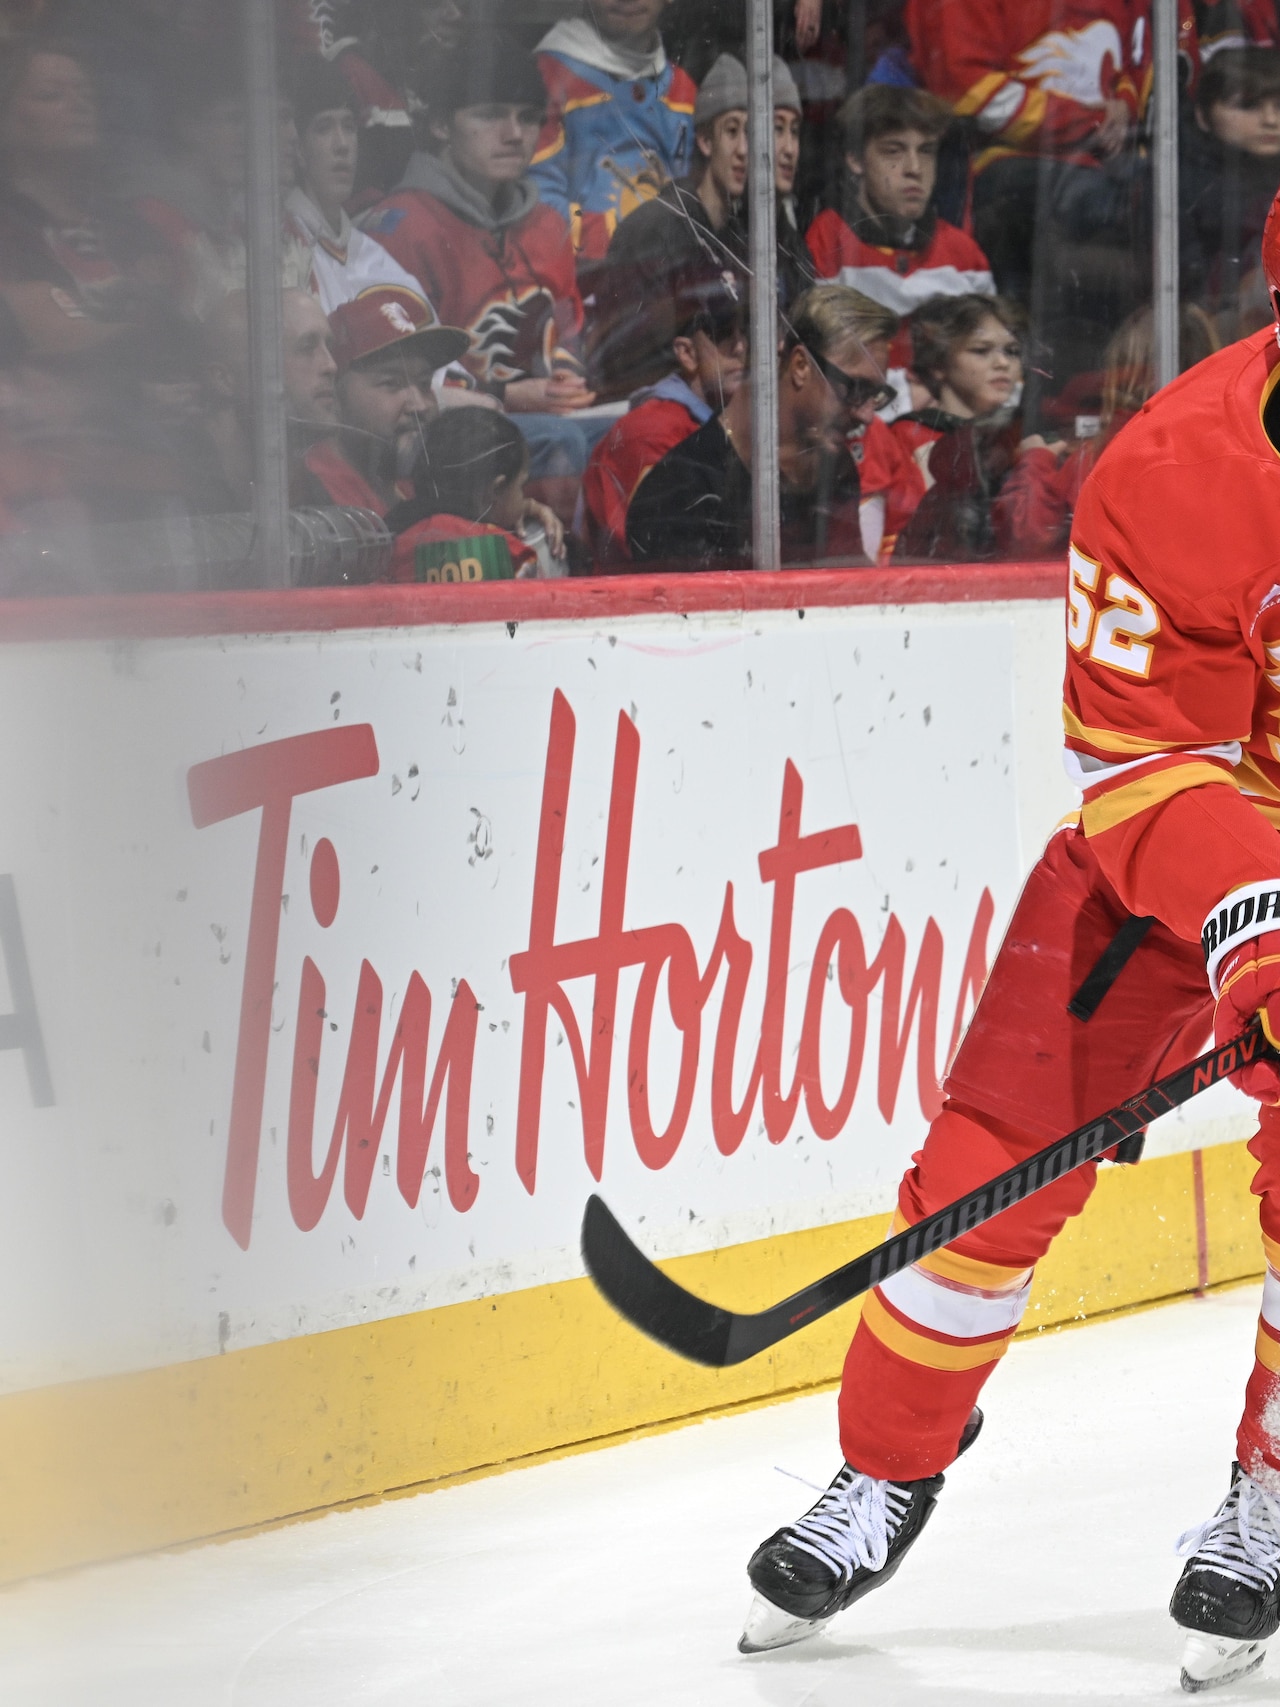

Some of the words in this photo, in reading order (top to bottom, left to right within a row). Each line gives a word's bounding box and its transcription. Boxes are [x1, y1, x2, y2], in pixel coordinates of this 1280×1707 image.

[1067, 542, 1162, 680] 52
[186, 722, 482, 1252] Tim
[868, 1123, 1107, 1288] WARRIOR
